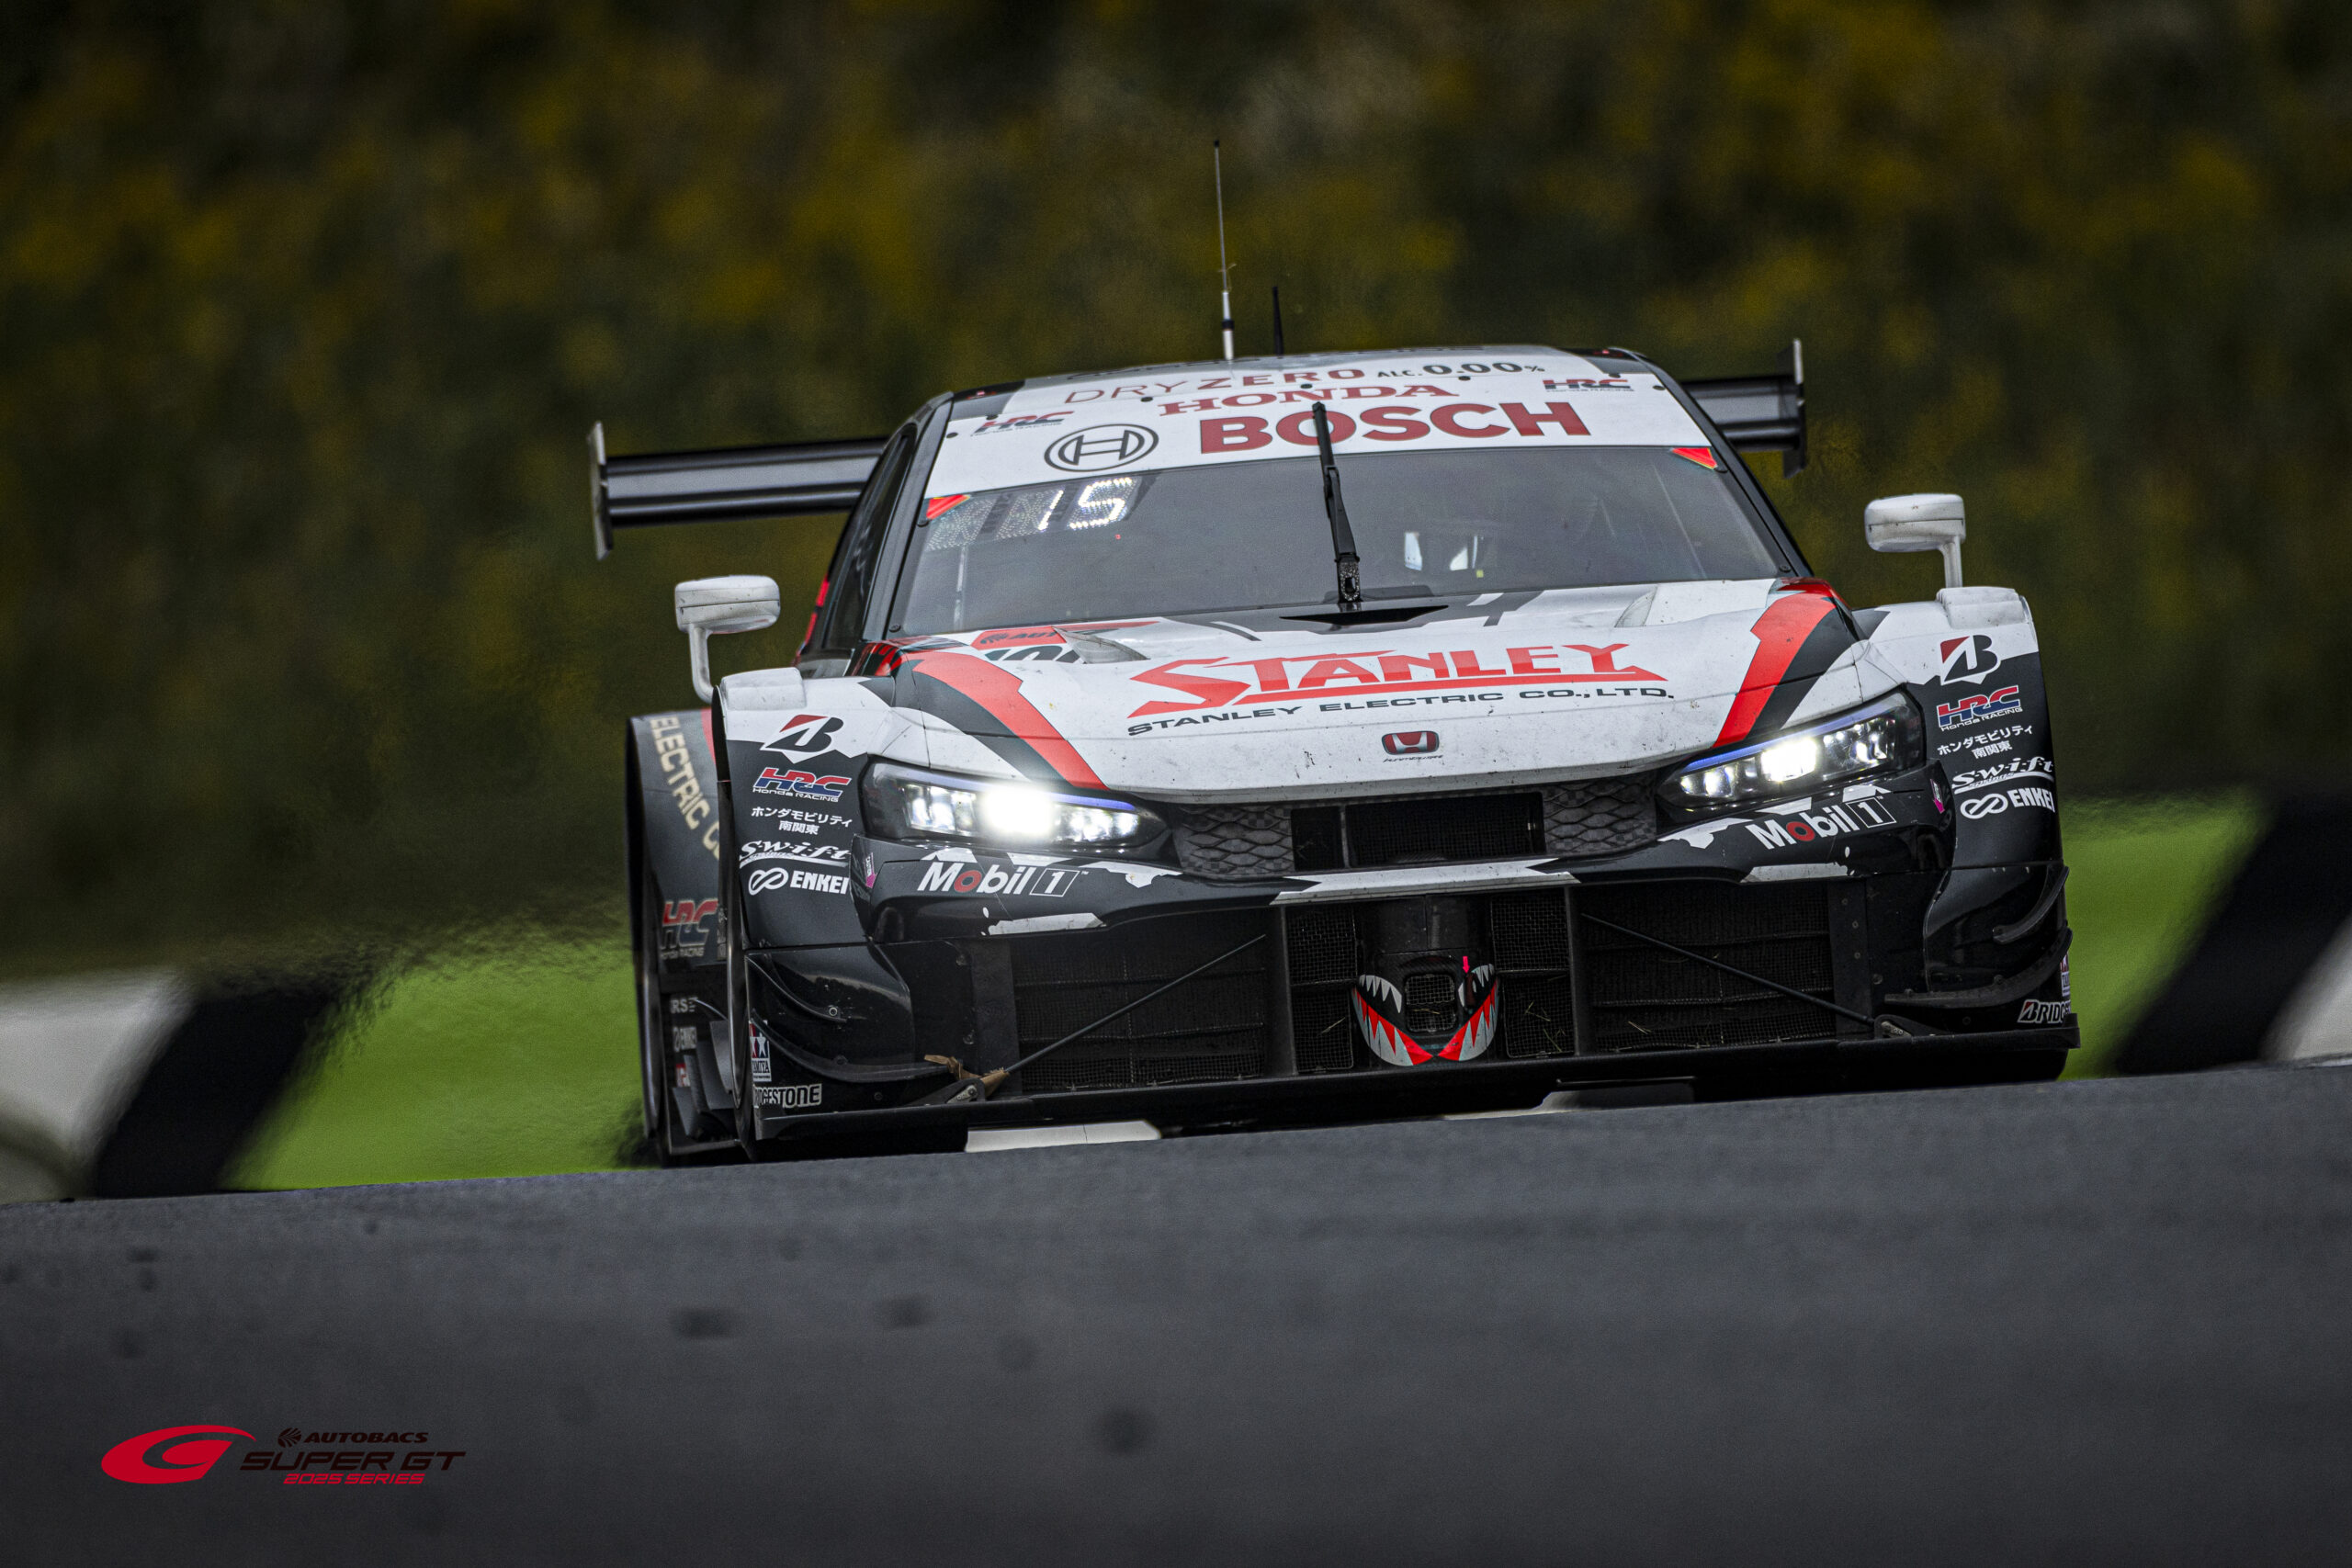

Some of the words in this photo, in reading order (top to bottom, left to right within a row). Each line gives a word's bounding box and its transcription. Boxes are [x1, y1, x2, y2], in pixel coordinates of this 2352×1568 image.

[1377, 369, 1422, 378] ALC.
[1543, 378, 1631, 389] HRC
[1158, 384, 1460, 416] HONDA
[974, 410, 1074, 434] HRC
[1200, 401, 1591, 455] BOSCH
[1127, 643, 1668, 718] STANLEY
[1127, 705, 1303, 737] STANLEY
[1319, 692, 1504, 712] ELECTRIC
[1936, 684, 2021, 728] HRC
[1980, 706, 2024, 722] RACING
[1937, 725, 2033, 756] ホンダモビリティ
[1972, 739, 2013, 760] 南関東
[650, 716, 711, 830] ELECTRIC
[753, 766, 853, 797] HRC
[795, 792, 840, 803] RACING
[2007, 787, 2056, 813] ENKEI
[751, 806, 854, 829] ホンダモビリティ
[778, 819, 820, 835] 南関東
[1745, 805, 1860, 850] Mobil
[790, 870, 850, 895] ENKEI
[917, 862, 1036, 895] Mobil
